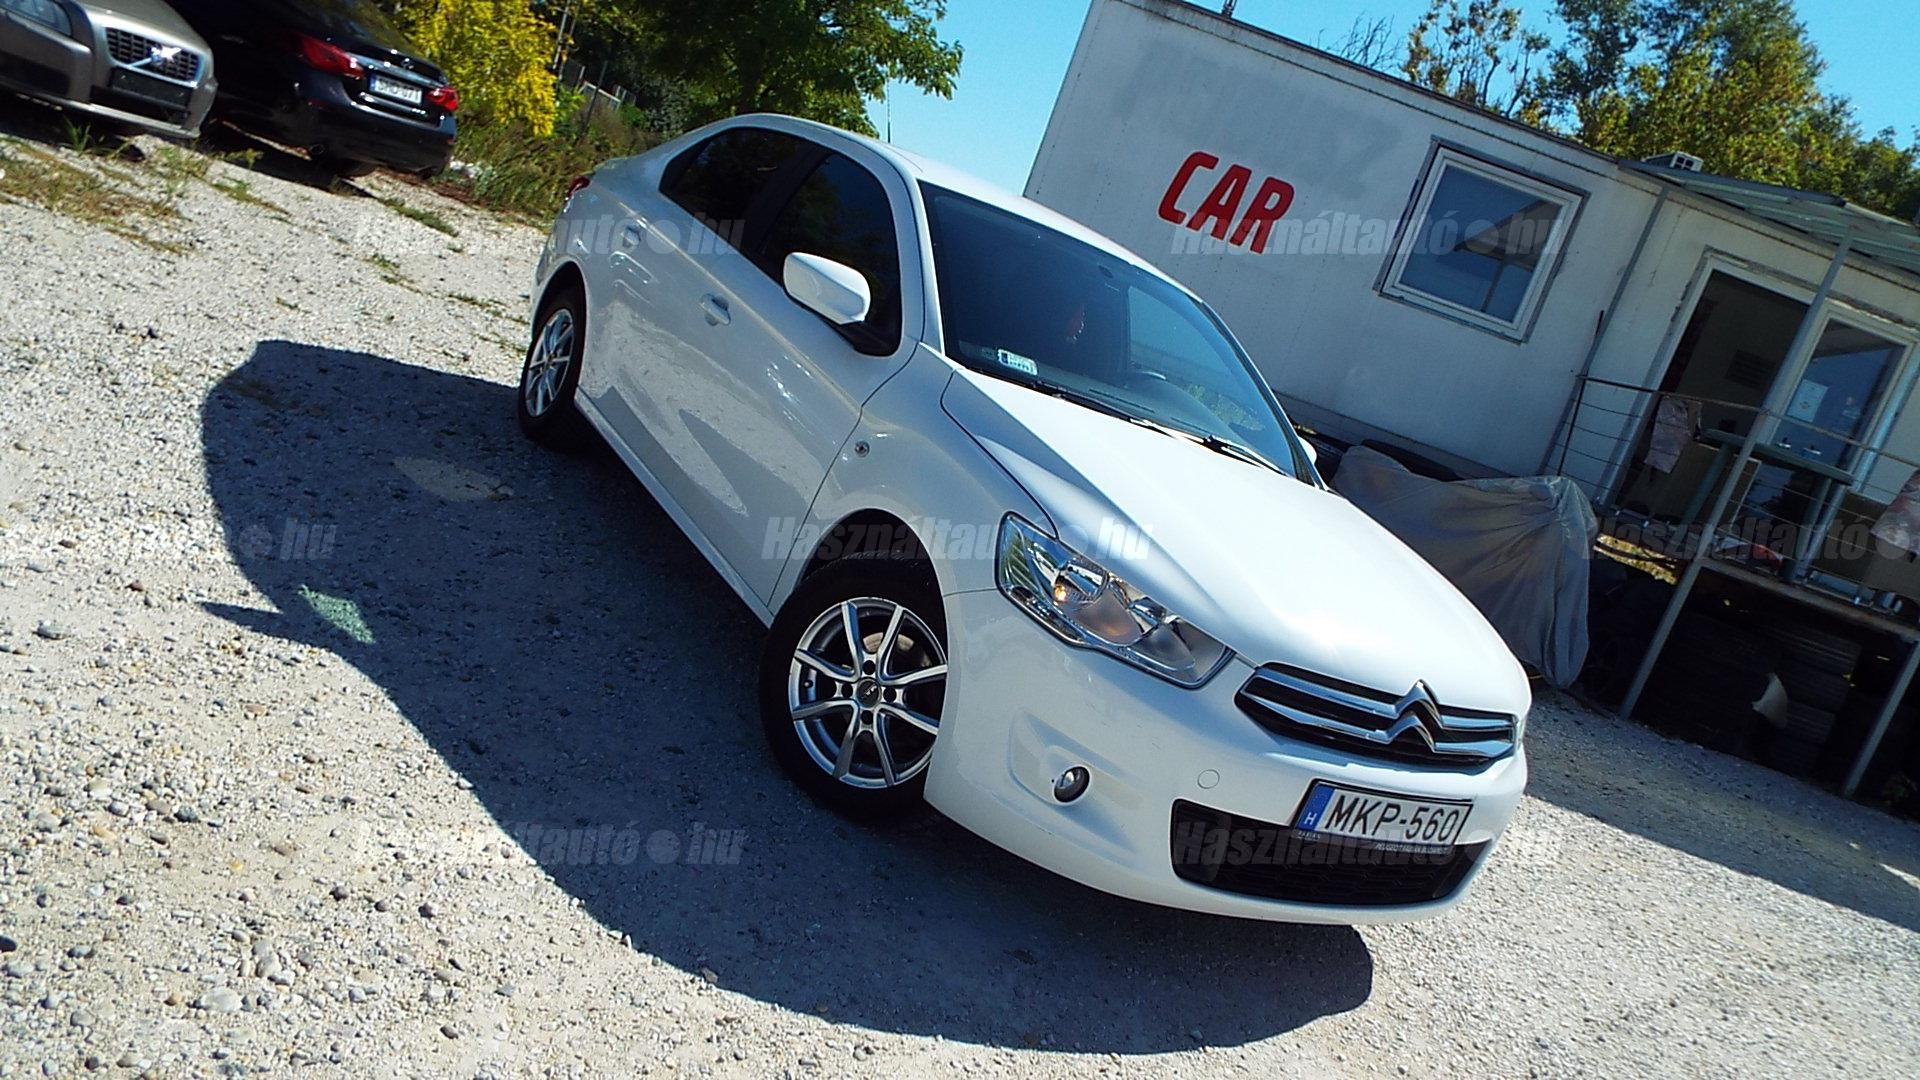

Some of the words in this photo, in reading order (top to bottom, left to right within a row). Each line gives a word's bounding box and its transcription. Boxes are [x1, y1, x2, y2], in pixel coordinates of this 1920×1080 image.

[1157, 151, 1295, 255] CAR
[1303, 812, 1317, 825] H
[1325, 795, 1460, 841] MKP-560
